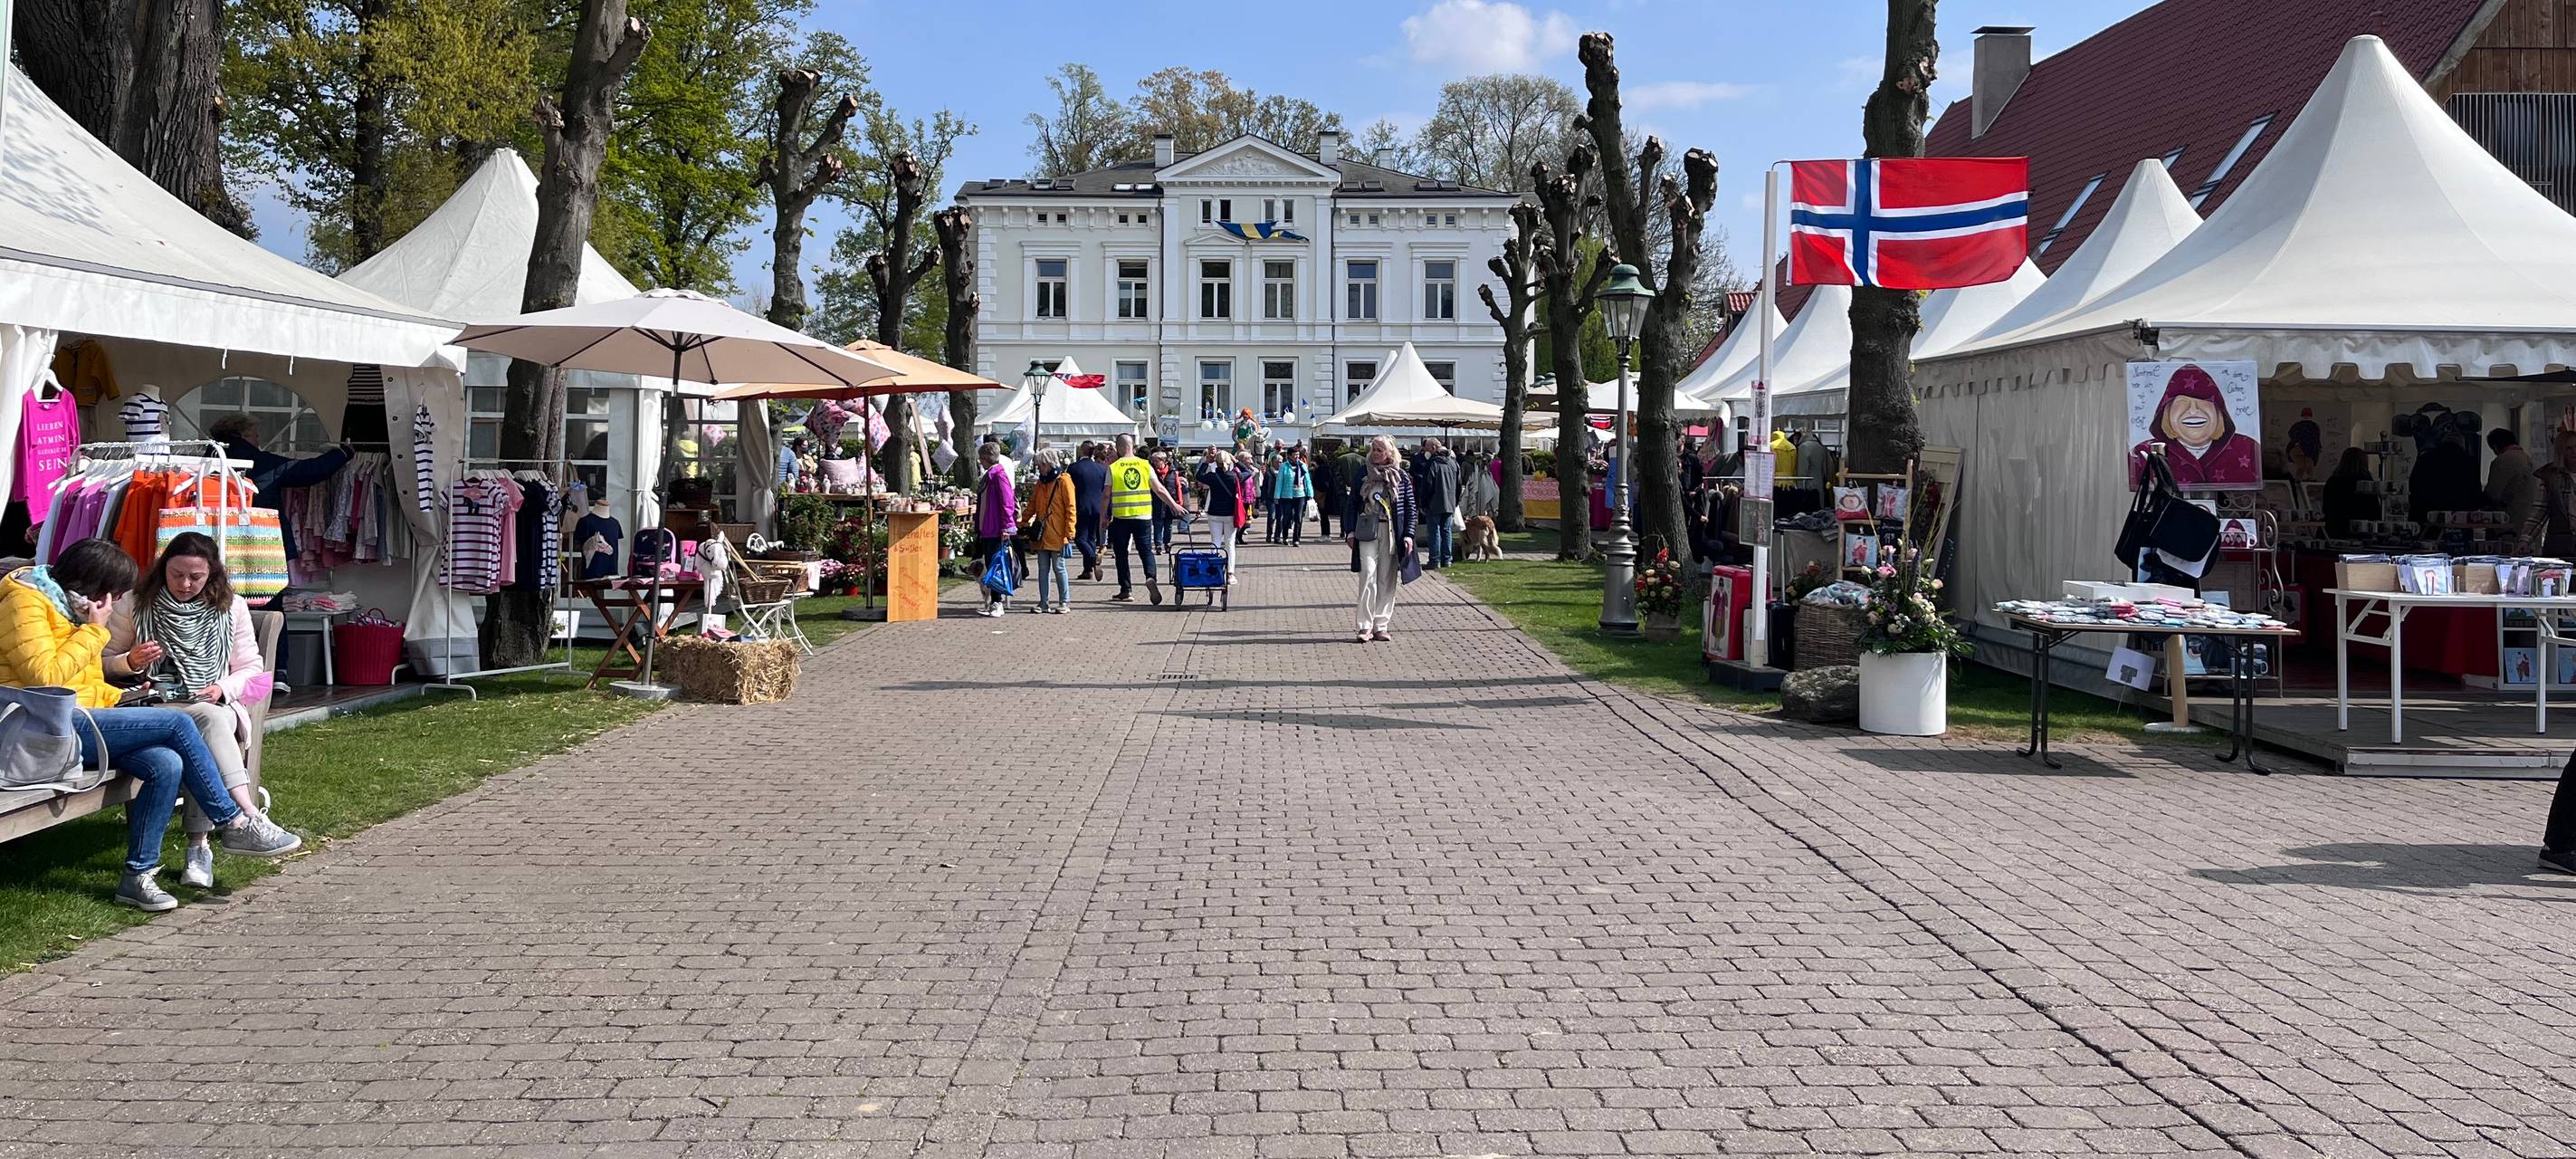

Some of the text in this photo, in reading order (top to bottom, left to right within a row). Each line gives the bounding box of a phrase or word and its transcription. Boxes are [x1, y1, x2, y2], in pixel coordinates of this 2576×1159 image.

[36, 420, 63, 431] LIEBEN
[37, 435, 65, 445] ATMEN
[38, 456, 68, 472] SEIN
